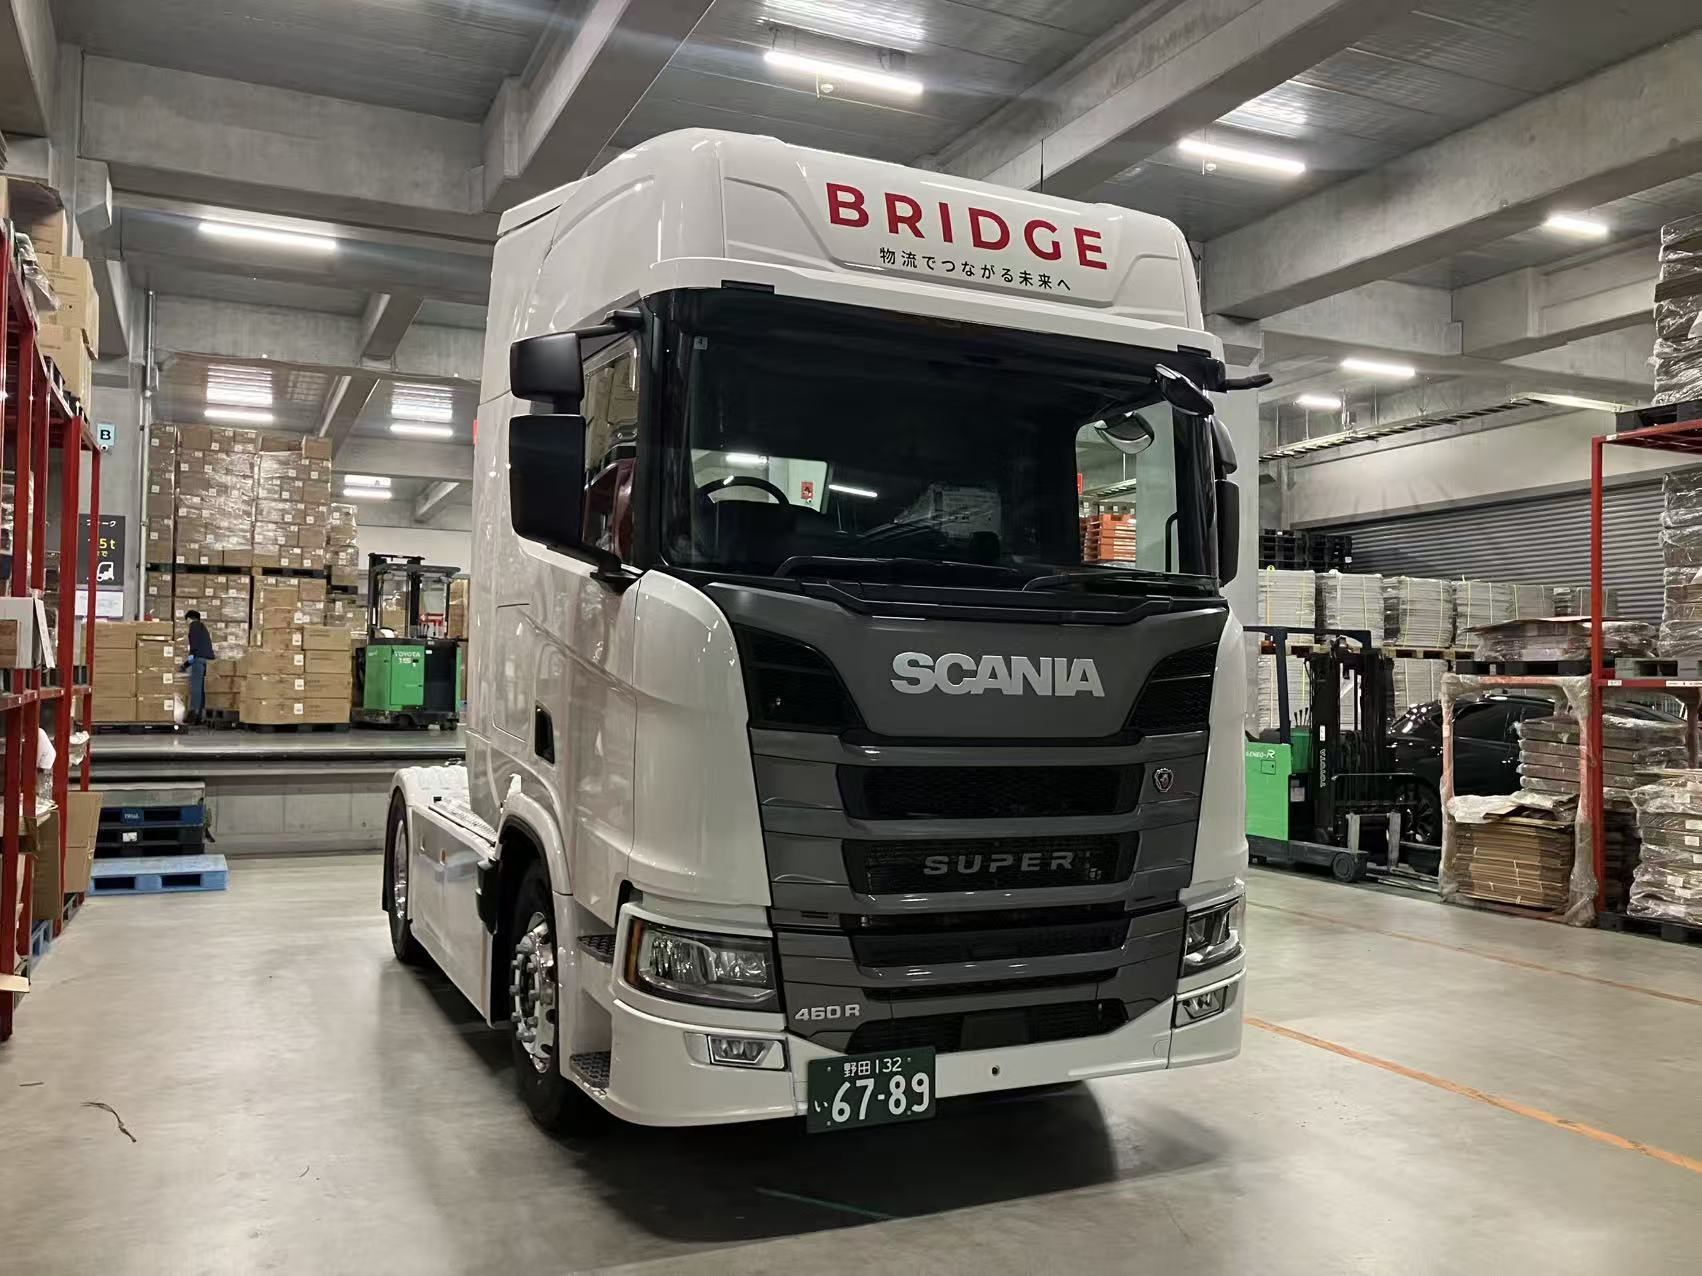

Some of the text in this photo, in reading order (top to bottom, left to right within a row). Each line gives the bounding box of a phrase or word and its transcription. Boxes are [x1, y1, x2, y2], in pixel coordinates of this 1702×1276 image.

[826, 182, 1108, 270] BRIDGE
[879, 247, 1071, 292] 物流でつながる未来へ
[100, 429, 111, 440] B
[890, 651, 1105, 698] SCANIA
[923, 851, 1075, 876] SUPER
[844, 1057, 902, 1078] 野田 132
[814, 1072, 930, 1123] い 67-89
